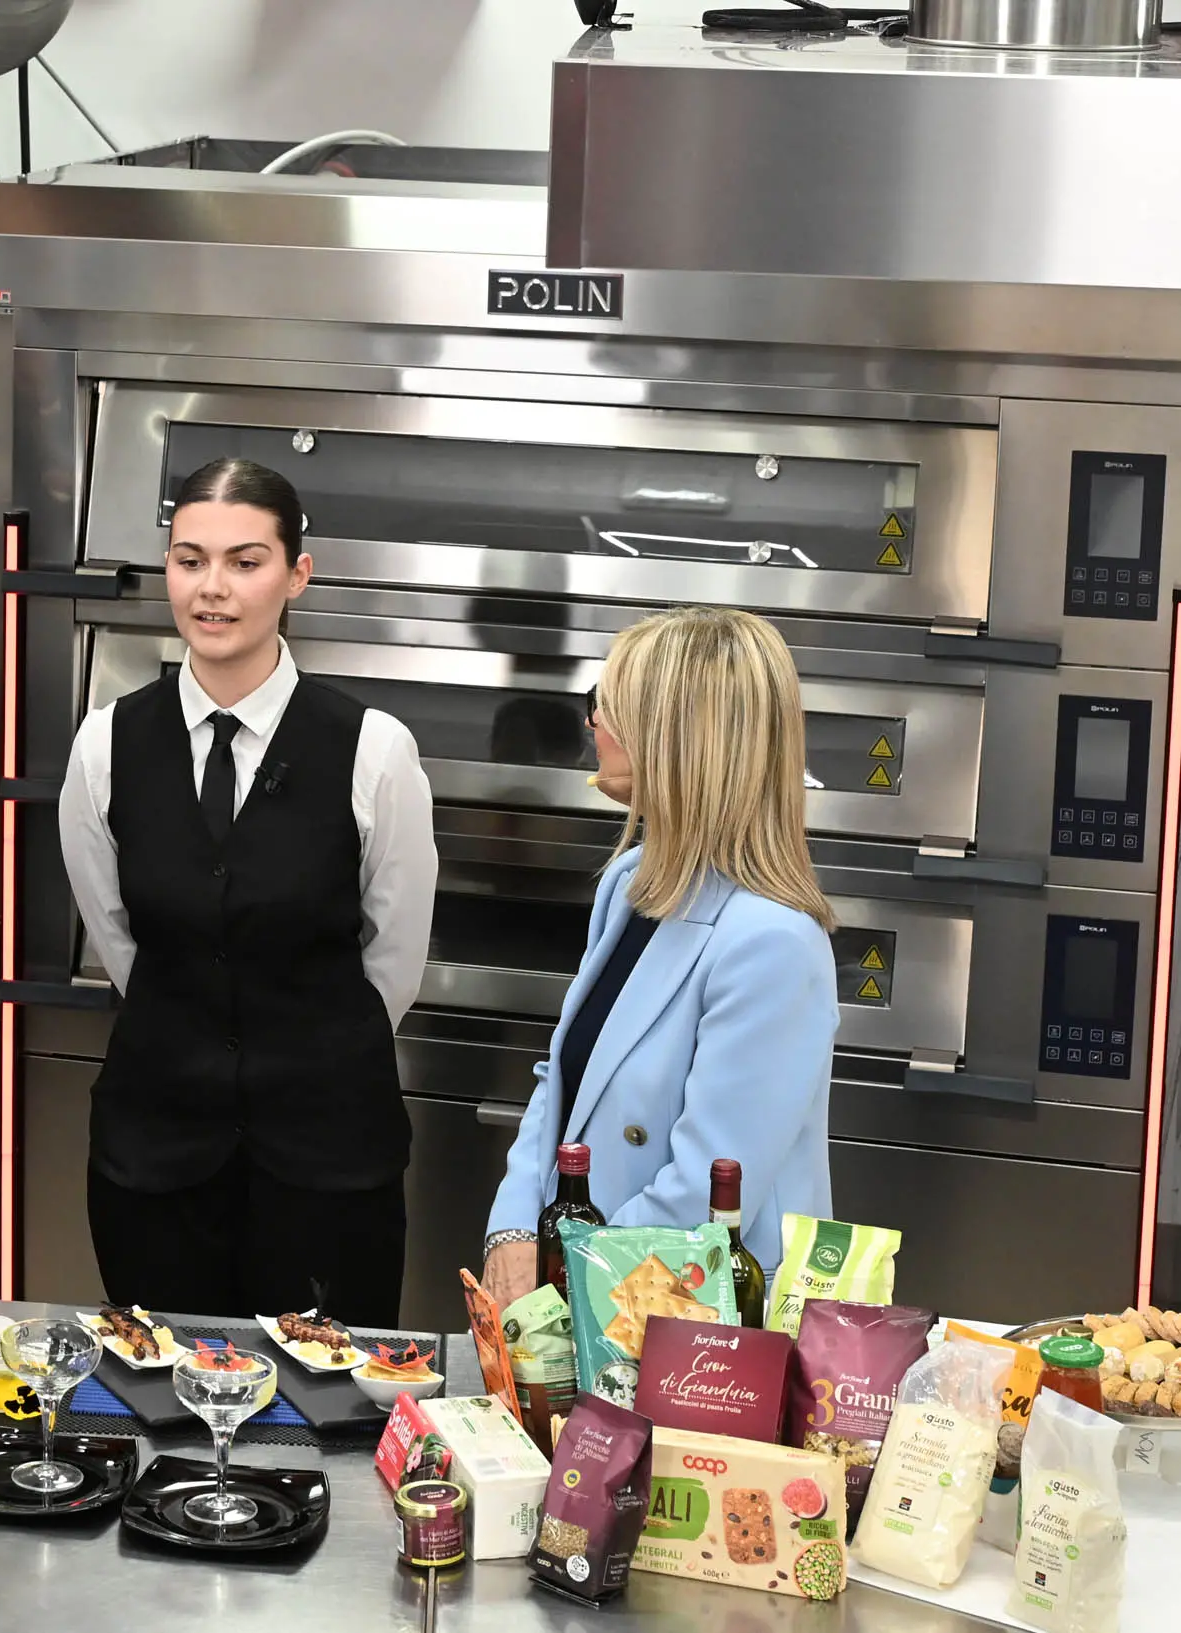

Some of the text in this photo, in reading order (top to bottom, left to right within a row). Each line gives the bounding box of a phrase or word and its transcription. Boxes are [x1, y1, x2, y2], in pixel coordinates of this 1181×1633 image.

[496, 277, 612, 313] POLIN
[691, 1351, 732, 1373] Cuor
[659, 1371, 764, 1402] di Gianduia
[806, 1378, 835, 1427] 3
[834, 1382, 897, 1412] Grani
[836, 1405, 868, 1420] Pregiati
[926, 1413, 955, 1428] gusto
[682, 1454, 728, 1478] coop
[1053, 1480, 1080, 1497] gusto
[652, 1486, 692, 1523] ALI
[1034, 1503, 1069, 1528] Farina
[520, 1502, 529, 1536] DIGESTIVE
[1030, 1516, 1073, 1542] lenticchie
[702, 1568, 720, 1580] 400g
